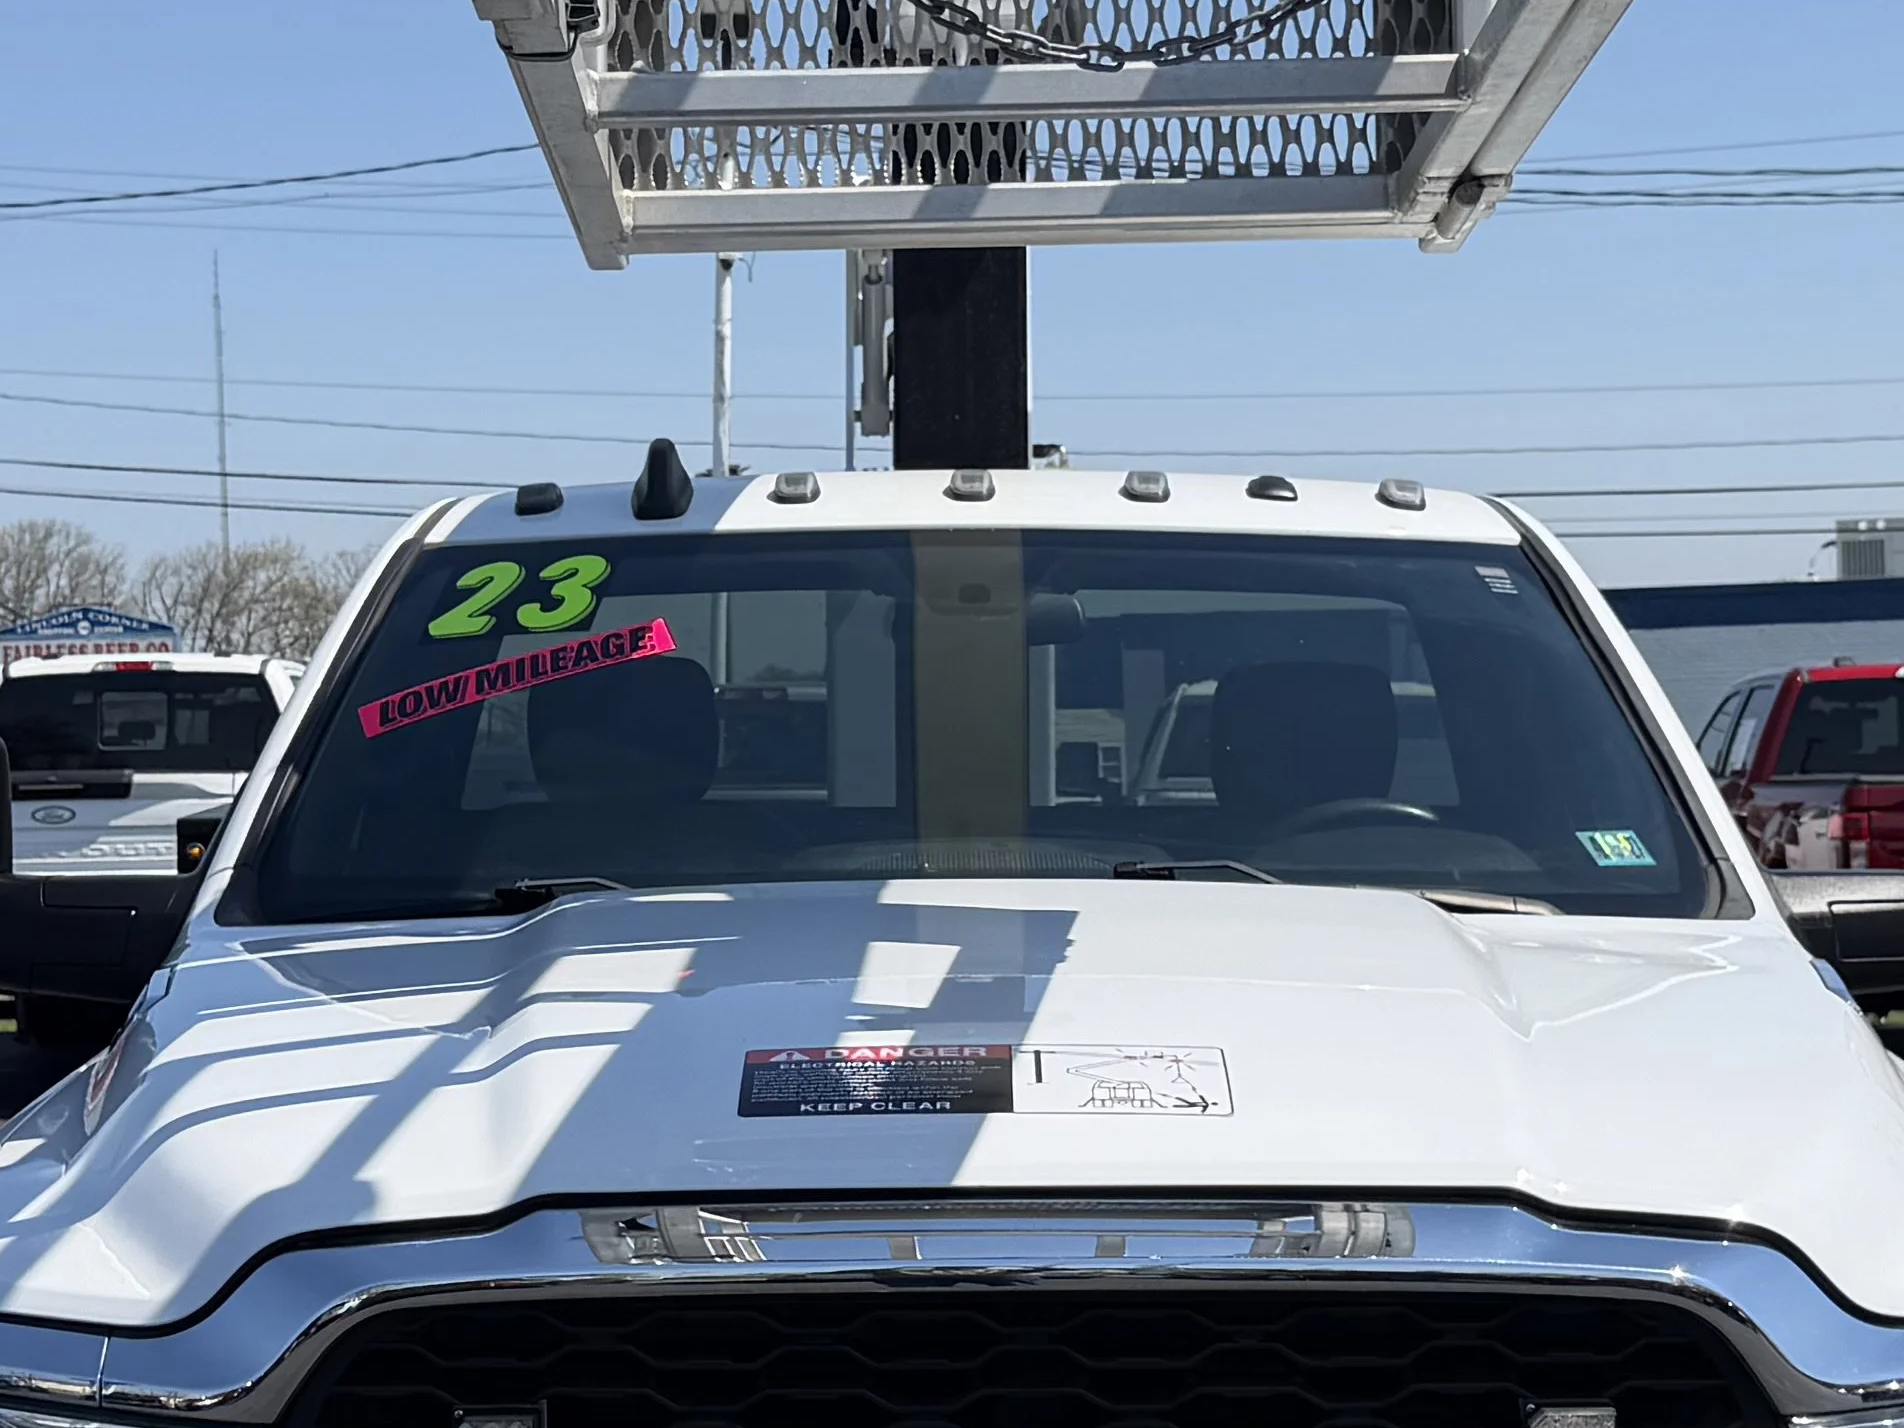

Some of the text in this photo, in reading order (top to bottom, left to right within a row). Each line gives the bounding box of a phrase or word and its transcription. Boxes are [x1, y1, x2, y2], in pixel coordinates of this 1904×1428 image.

[428, 554, 612, 639] 23
[17, 611, 150, 634] LINCOLN CORNER
[379, 624, 658, 728] LOW MILEAGE
[824, 1046, 988, 1061] DANGER
[780, 1061, 886, 1069] ELECTRICAL
[800, 1101, 952, 1112] KEEP CLEAR
